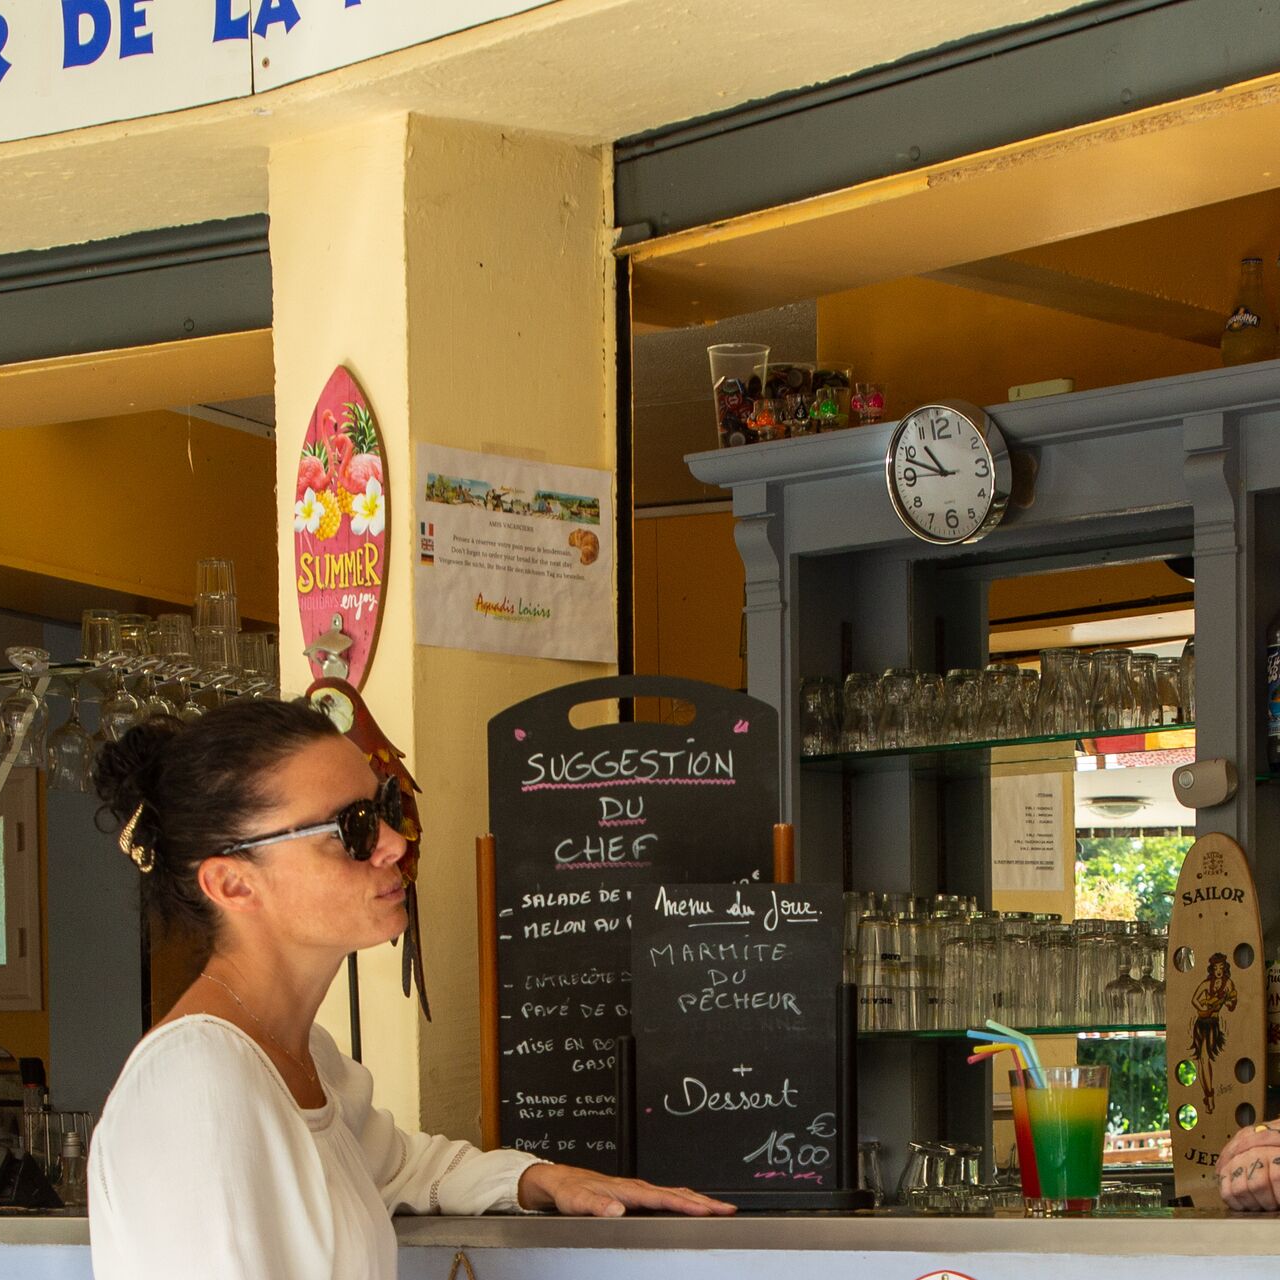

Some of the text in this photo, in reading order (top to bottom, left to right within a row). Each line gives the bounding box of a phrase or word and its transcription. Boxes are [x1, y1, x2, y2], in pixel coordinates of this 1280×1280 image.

[62, 0, 153, 68] DE
[918, 427, 925, 440] 11
[931, 417, 952, 440] 12
[905, 446, 917, 460] 10
[970, 437, 980, 450] 2
[903, 467, 917, 487] 9
[975, 458, 990, 478] 3
[913, 496, 923, 509] 8
[977, 488, 986, 499] 4
[928, 512, 935, 528] 7
[945, 509, 959, 529] 6
[967, 508, 976, 520] 5
[297, 542, 382, 594] SUMMER
[340, 592, 378, 621] enjoy
[475, 592, 551, 619] Aquadis Loisirs
[522, 738, 734, 785] SUGGESTION
[599, 796, 644, 820] DU
[554, 833, 659, 863] CHEF
[521, 889, 620, 909] SALADE DE
[654, 886, 715, 917] Menu
[726, 890, 756, 917] du
[1182, 886, 1245, 907] SAILOR
[523, 918, 620, 939] MELON AU
[650, 935, 787, 967] MARMITE
[524, 967, 615, 991] ENTRECÔTE
[707, 969, 747, 986] DU
[521, 997, 570, 1020] PAVÉ
[580, 1003, 606, 1019] DE
[678, 988, 802, 1015] PÊCHEUR
[516, 1037, 554, 1056] MISE
[564, 1037, 585, 1051] EN
[572, 1055, 616, 1072] GASP
[732, 1063, 753, 1077] +
[515, 1091, 568, 1105] SALADE
[664, 1076, 798, 1115] Dessert
[548, 1108, 565, 1117] DE
[515, 1132, 550, 1150] PAVÉ
[558, 1139, 576, 1150] DE
[742, 1130, 830, 1173] 15,00
